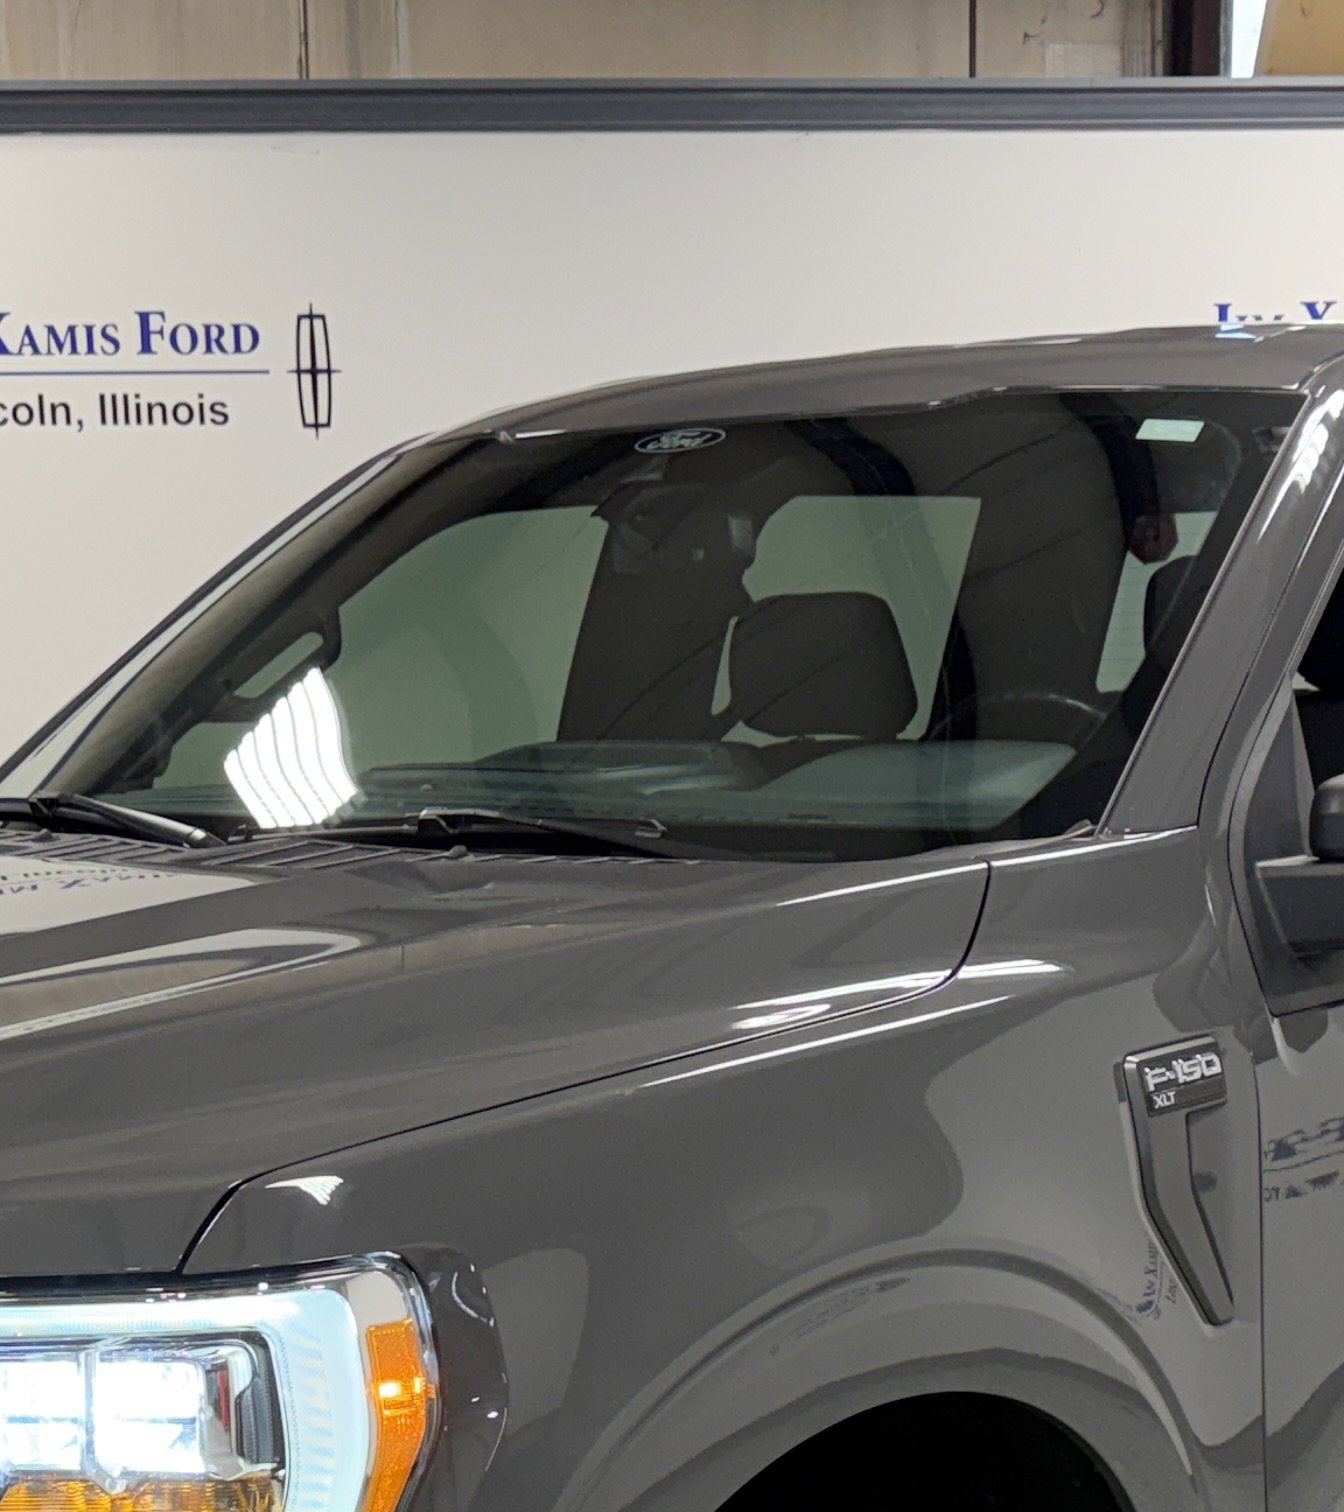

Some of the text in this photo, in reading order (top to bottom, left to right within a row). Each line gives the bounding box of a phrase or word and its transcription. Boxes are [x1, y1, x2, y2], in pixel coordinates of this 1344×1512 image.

[134, 310, 260, 356] FORD
[98, 394, 230, 427] Illinois
[1144, 1052, 1222, 1091] F-150
[1152, 1091, 1176, 1109] XLT
